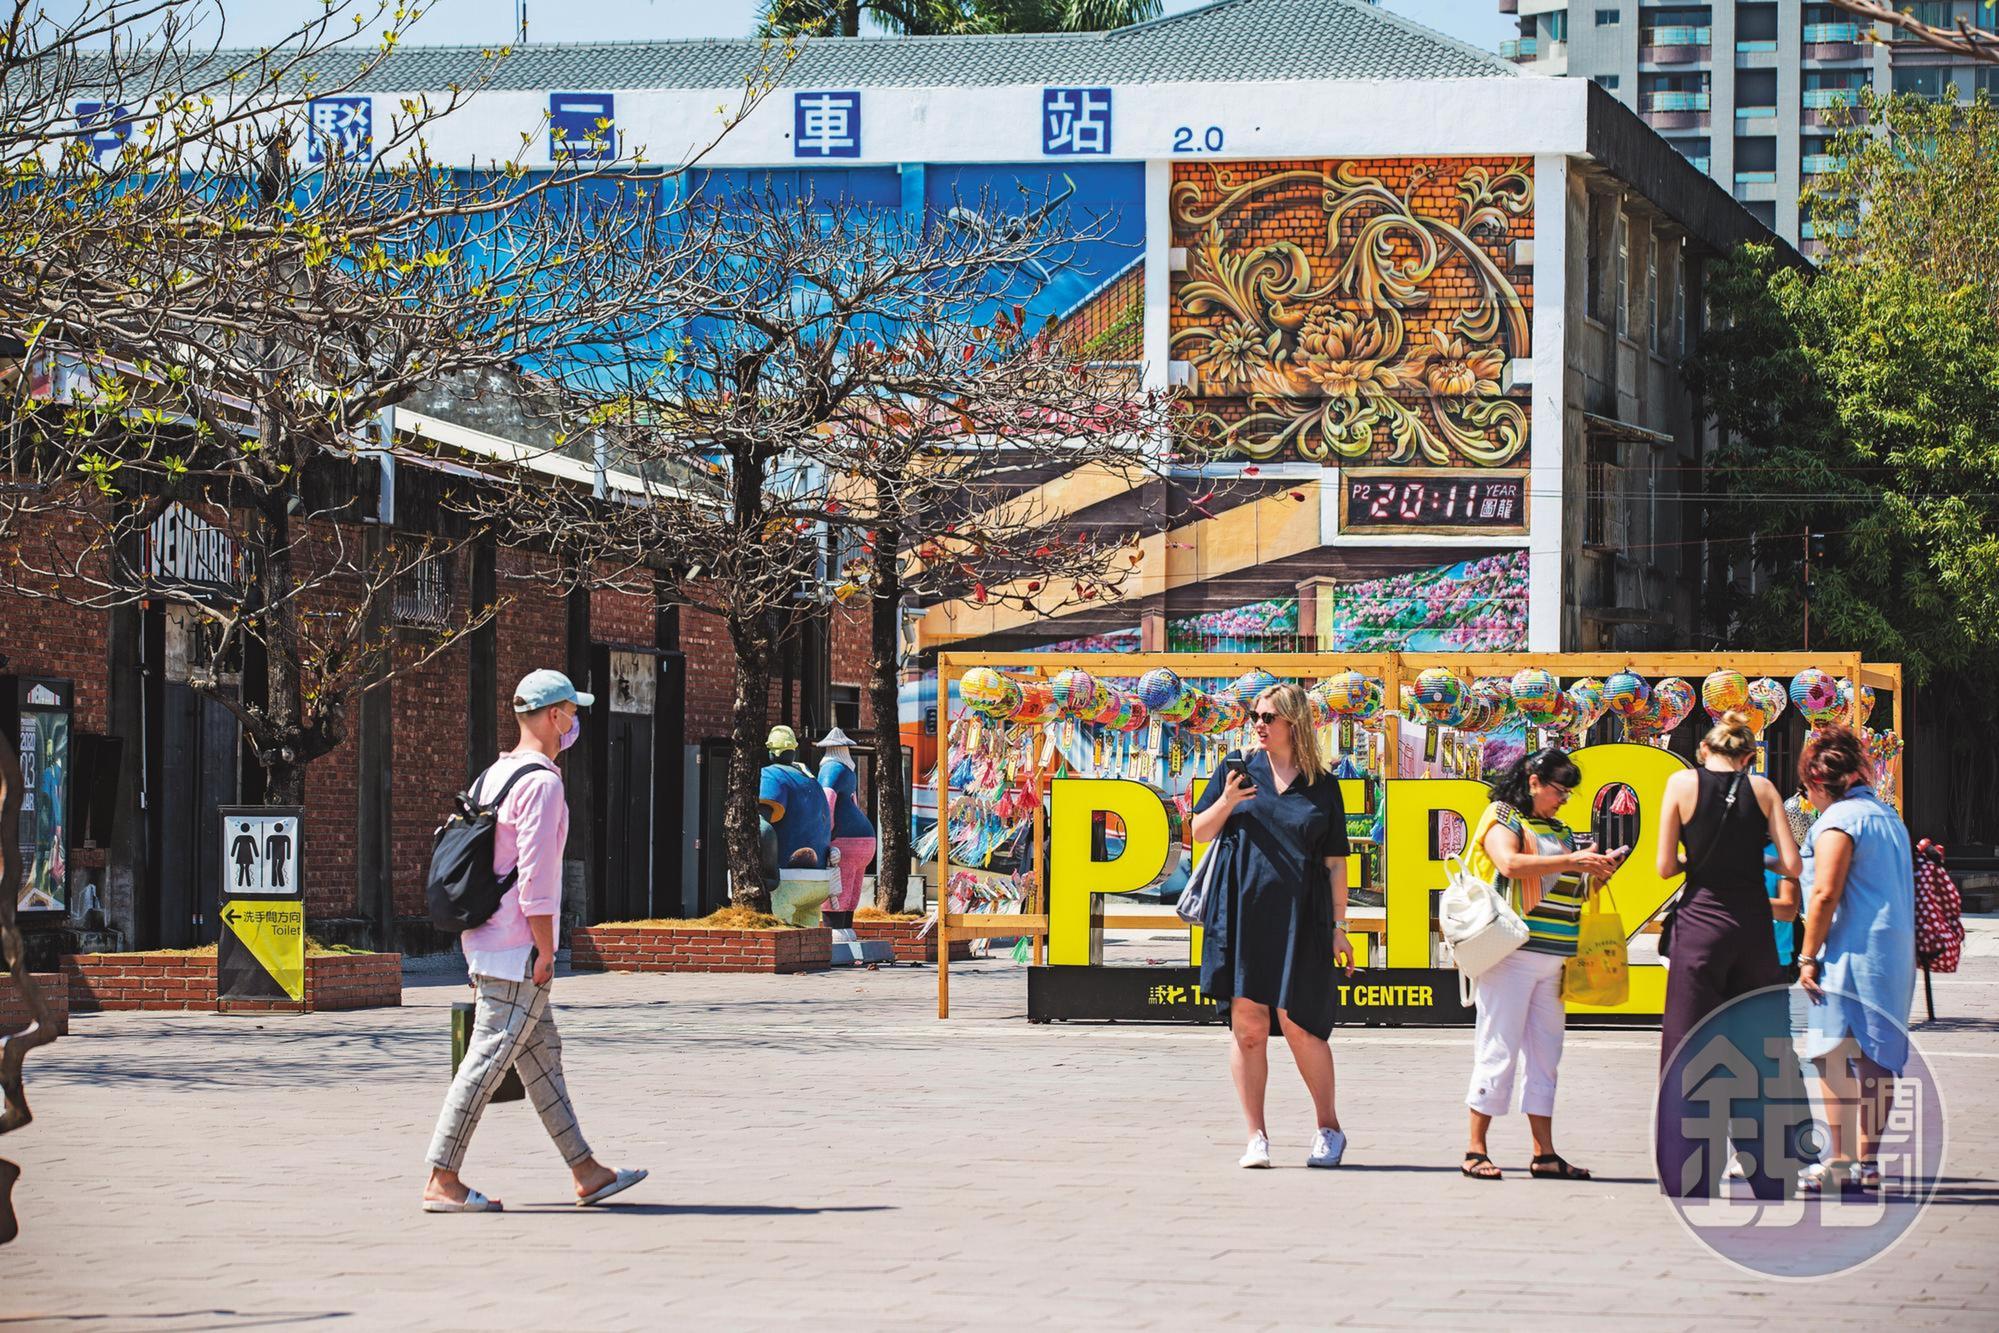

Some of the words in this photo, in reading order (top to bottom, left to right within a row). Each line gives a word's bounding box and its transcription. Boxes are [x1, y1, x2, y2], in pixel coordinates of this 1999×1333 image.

[1173, 126, 1223, 152] 2.0
[1352, 484, 1371, 500] P2
[1371, 482, 1478, 519] 20:11
[1486, 484, 1517, 497] YEAR
[1480, 498, 1513, 519] 圖龍
[243, 910, 301, 924] 洗手間方向
[271, 924, 301, 936] Toilet
[1354, 985, 1434, 1007] CENTER
